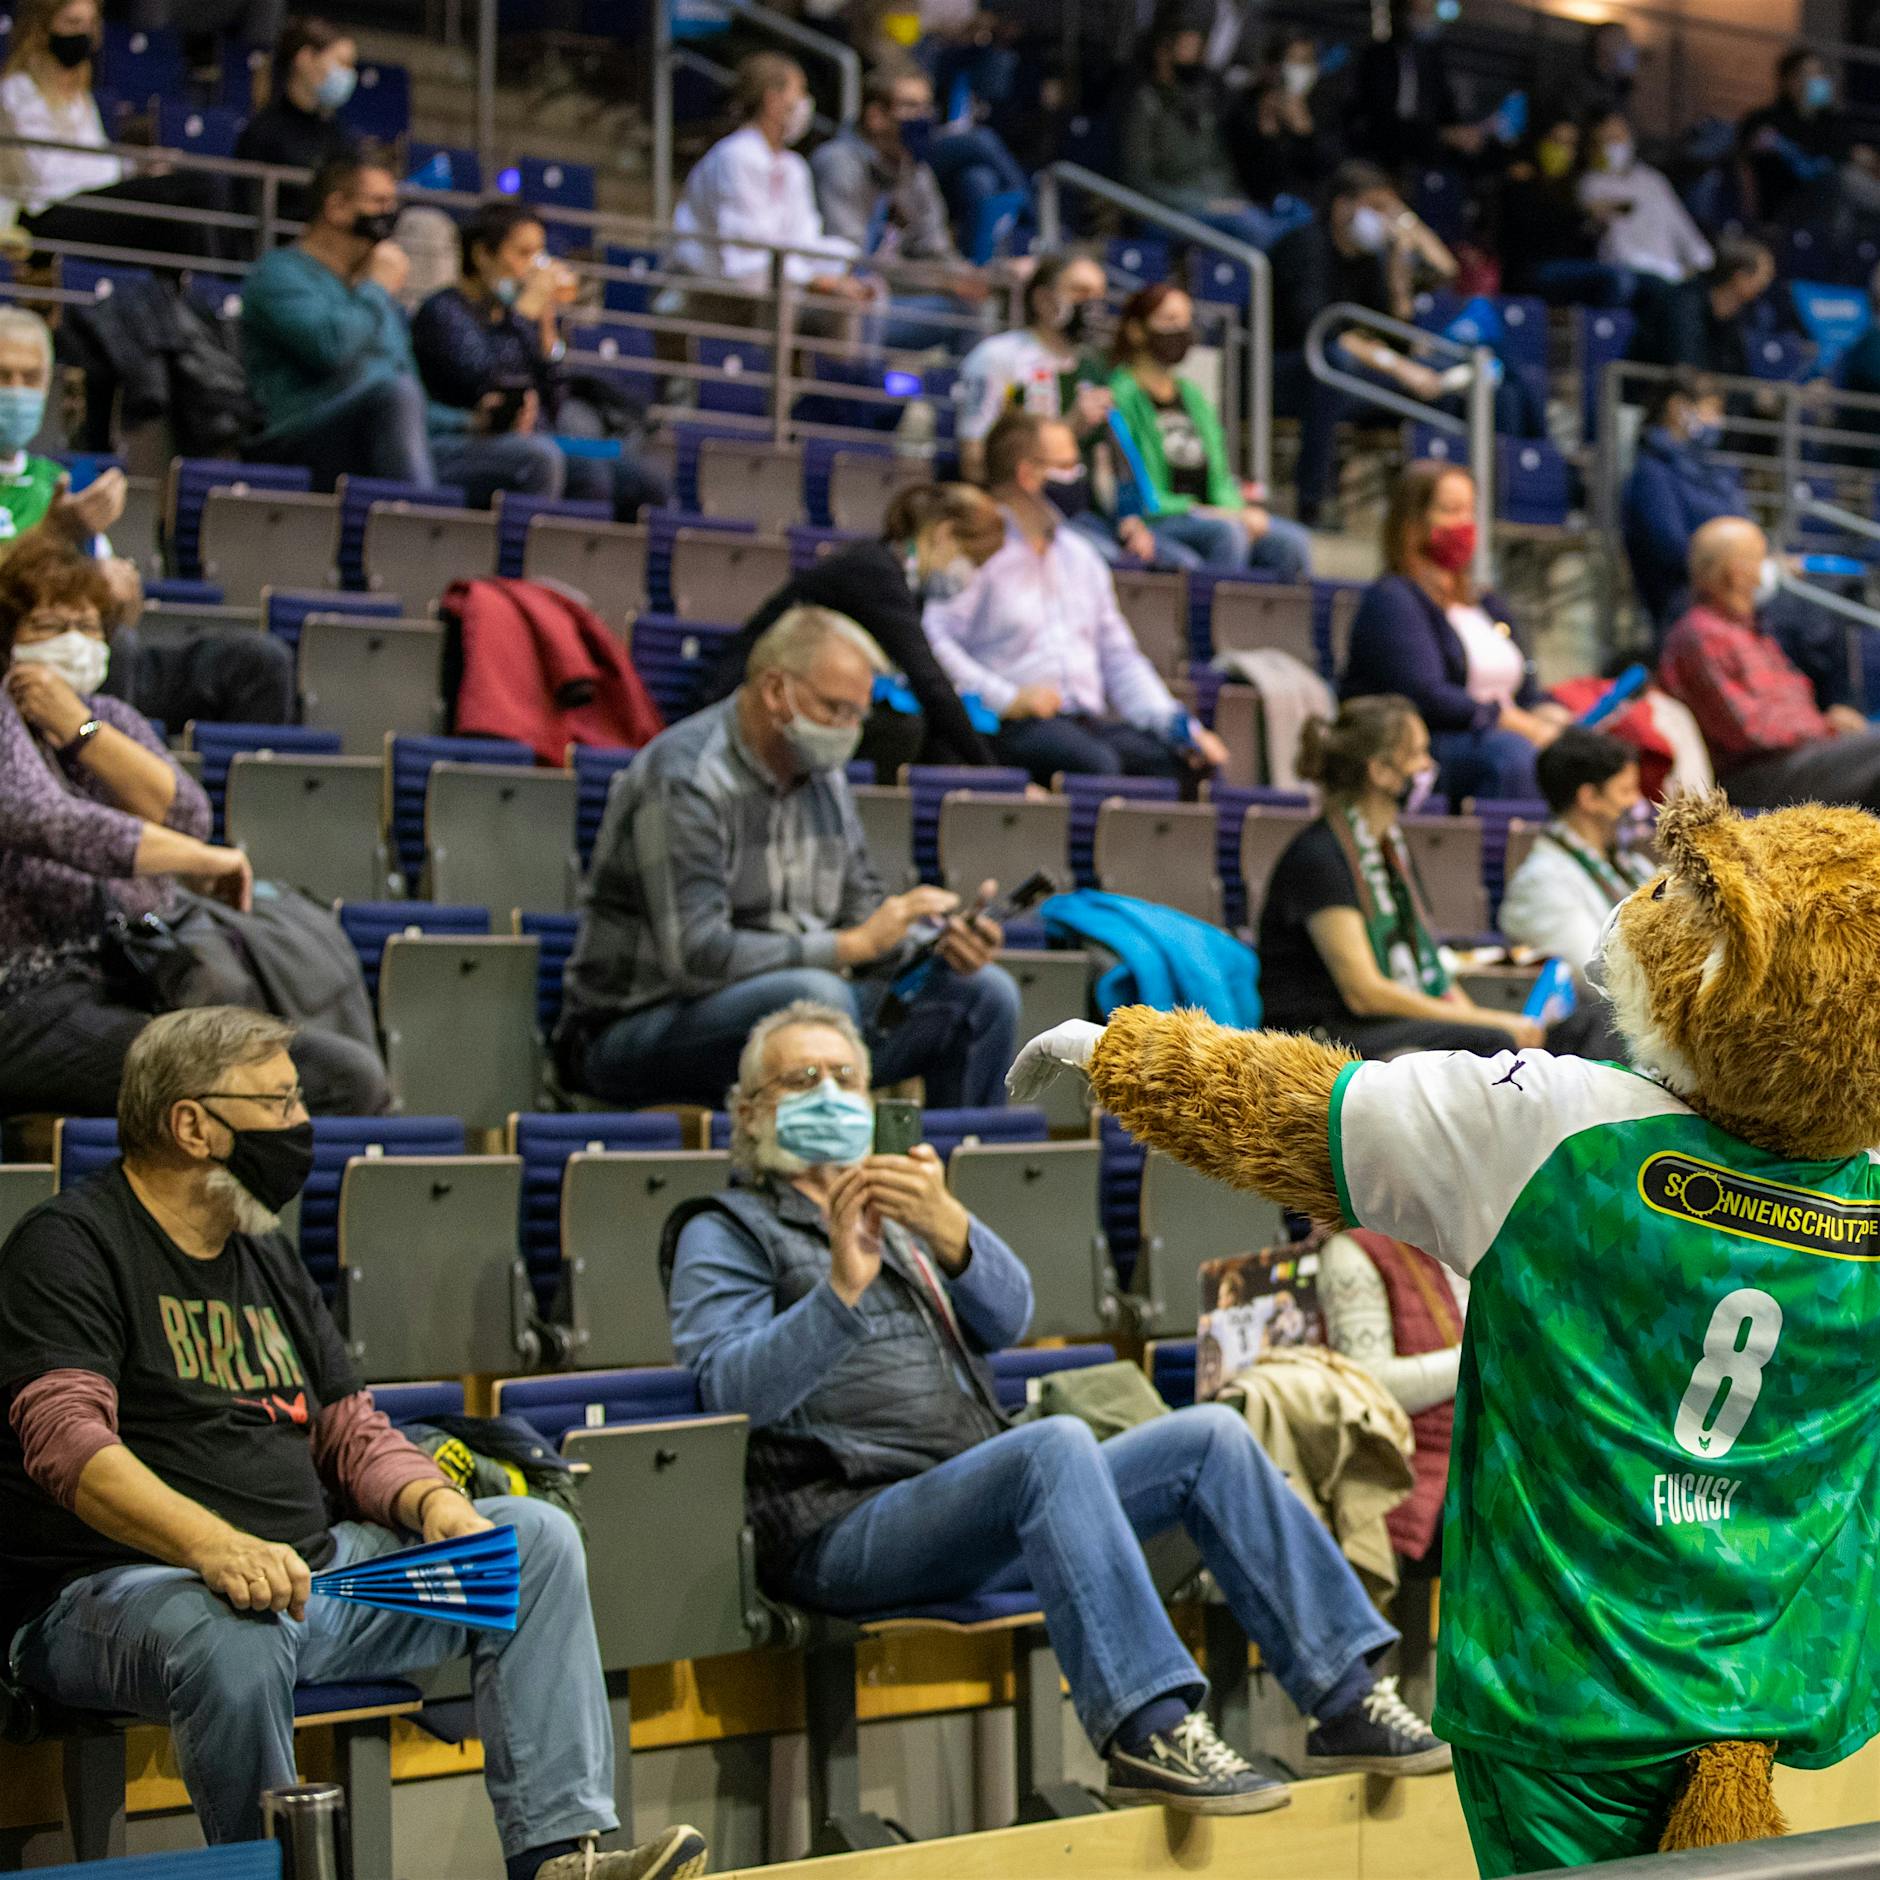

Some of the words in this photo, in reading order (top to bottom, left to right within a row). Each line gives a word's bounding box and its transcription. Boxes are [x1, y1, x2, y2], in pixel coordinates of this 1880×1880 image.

[158, 1294, 304, 1391] BERLIN
[1674, 1288, 1783, 1458] 8
[1653, 1472, 1742, 1526] FUCHSI
